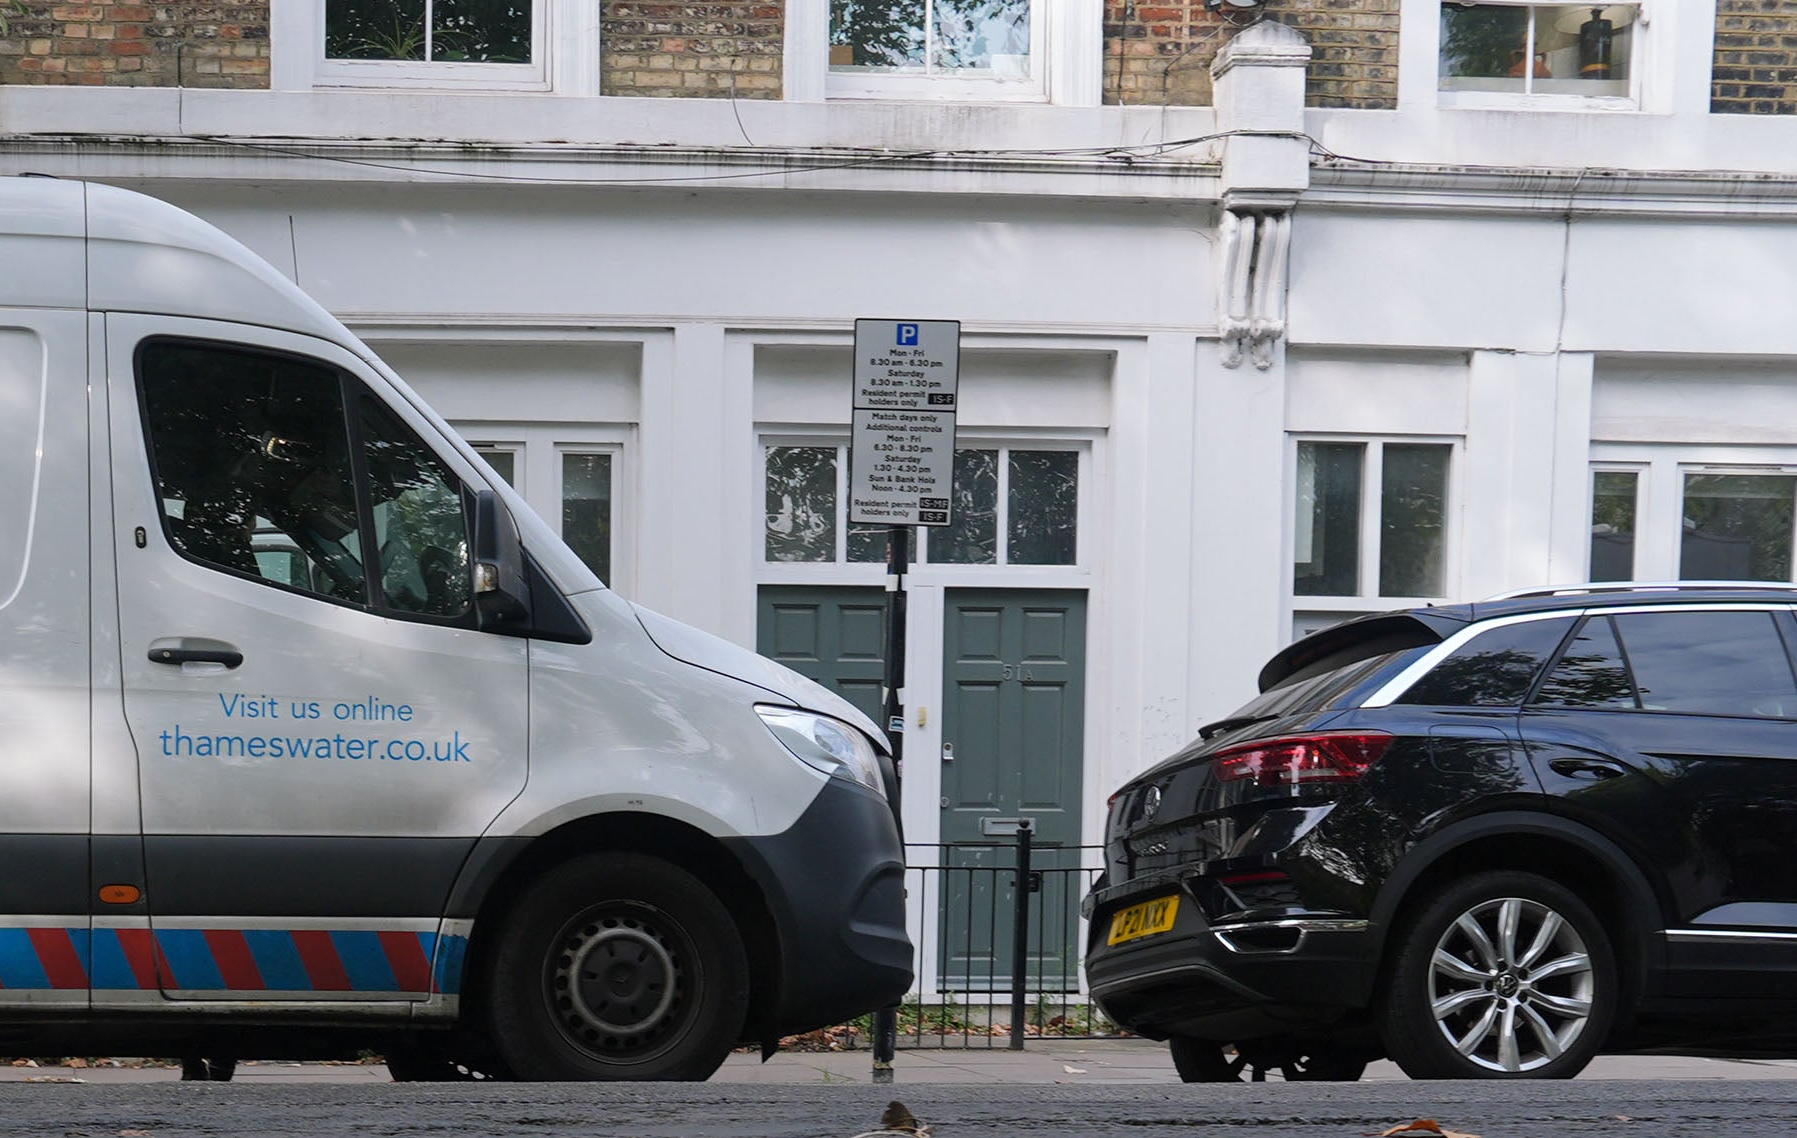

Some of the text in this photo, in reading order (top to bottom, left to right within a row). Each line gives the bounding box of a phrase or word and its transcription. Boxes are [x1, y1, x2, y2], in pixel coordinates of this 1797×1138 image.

[902, 326, 916, 344] P
[889, 349, 907, 357] Mon
[870, 358, 890, 366] 8.30
[930, 360, 943, 368] pm
[887, 369, 925, 379] Saturday
[909, 379, 928, 387] 1.30
[861, 389, 926, 399] Resident permit
[868, 398, 918, 408] holders only
[871, 412, 938, 423] Match days only
[865, 423, 943, 433] Additional controls
[886, 434, 904, 442] Mon
[910, 435, 922, 443] Fri
[874, 443, 893, 451] 6.30
[920, 446, 933, 454] pm
[884, 454, 922, 464] Saturday
[874, 464, 892, 472] 1.30
[897, 465, 918, 473] 4.30
[918, 466, 931, 474] pm
[868, 474, 885, 482] Sun
[895, 475, 915, 483] Bank
[917, 476, 936, 484] Hols
[871, 484, 893, 492] Noon
[898, 485, 919, 493] 4.30
[919, 486, 933, 494] pm
[854, 499, 917, 509] Resident permit
[861, 508, 909, 518] holders only
[219, 693, 413, 721] Visit us online
[159, 724, 471, 762] thameswater.co.uk
